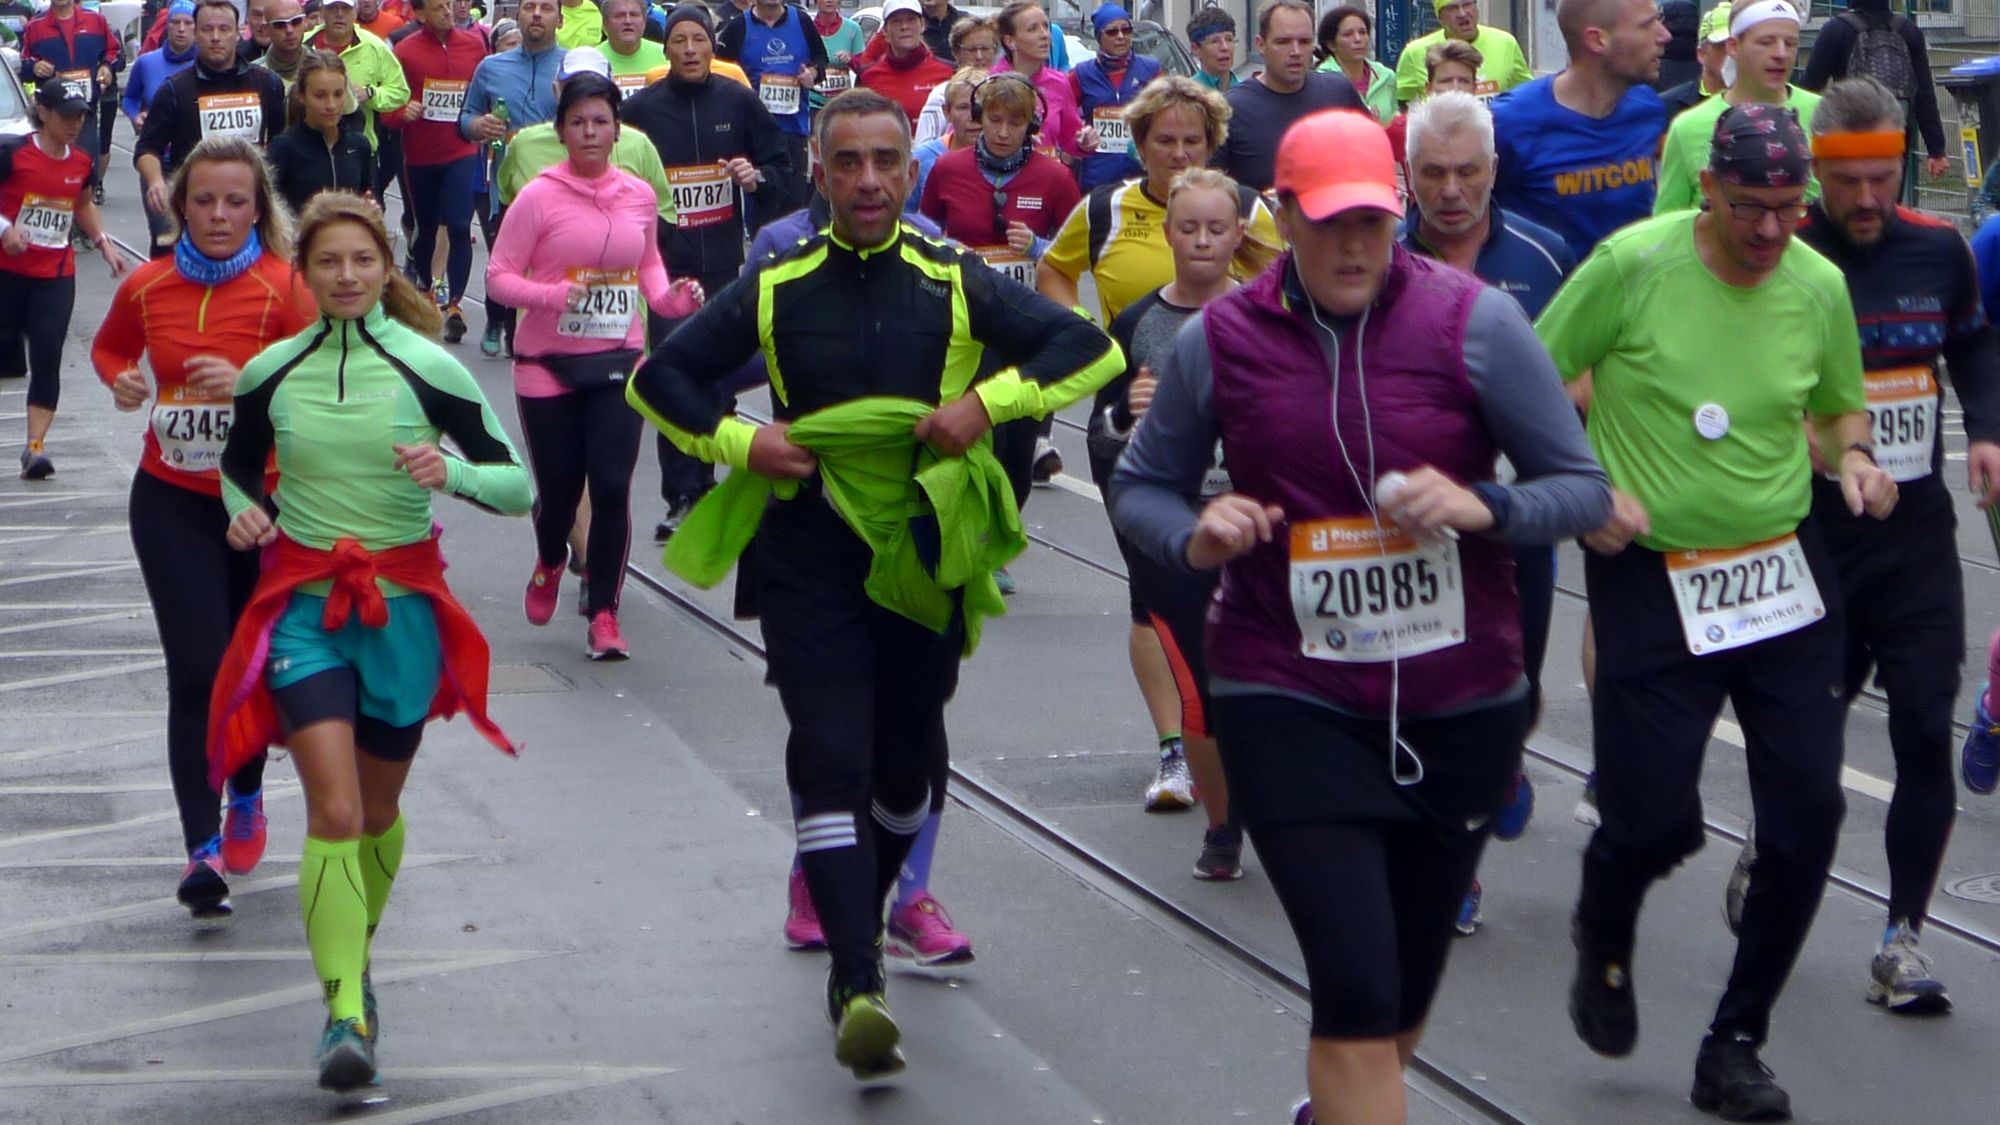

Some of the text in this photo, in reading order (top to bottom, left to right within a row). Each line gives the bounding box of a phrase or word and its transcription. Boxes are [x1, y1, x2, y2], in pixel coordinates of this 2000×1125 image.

[428, 92, 463, 108] 22246
[208, 109, 253, 130] 22105
[672, 183, 724, 210] 40787
[23, 208, 68, 232] 23048
[690, 215, 722, 227] Sparkasse
[573, 289, 628, 315] 2429
[1311, 558, 1439, 619] 20985
[1689, 554, 1796, 615] 22222
[1749, 602, 1806, 629] Melkus
